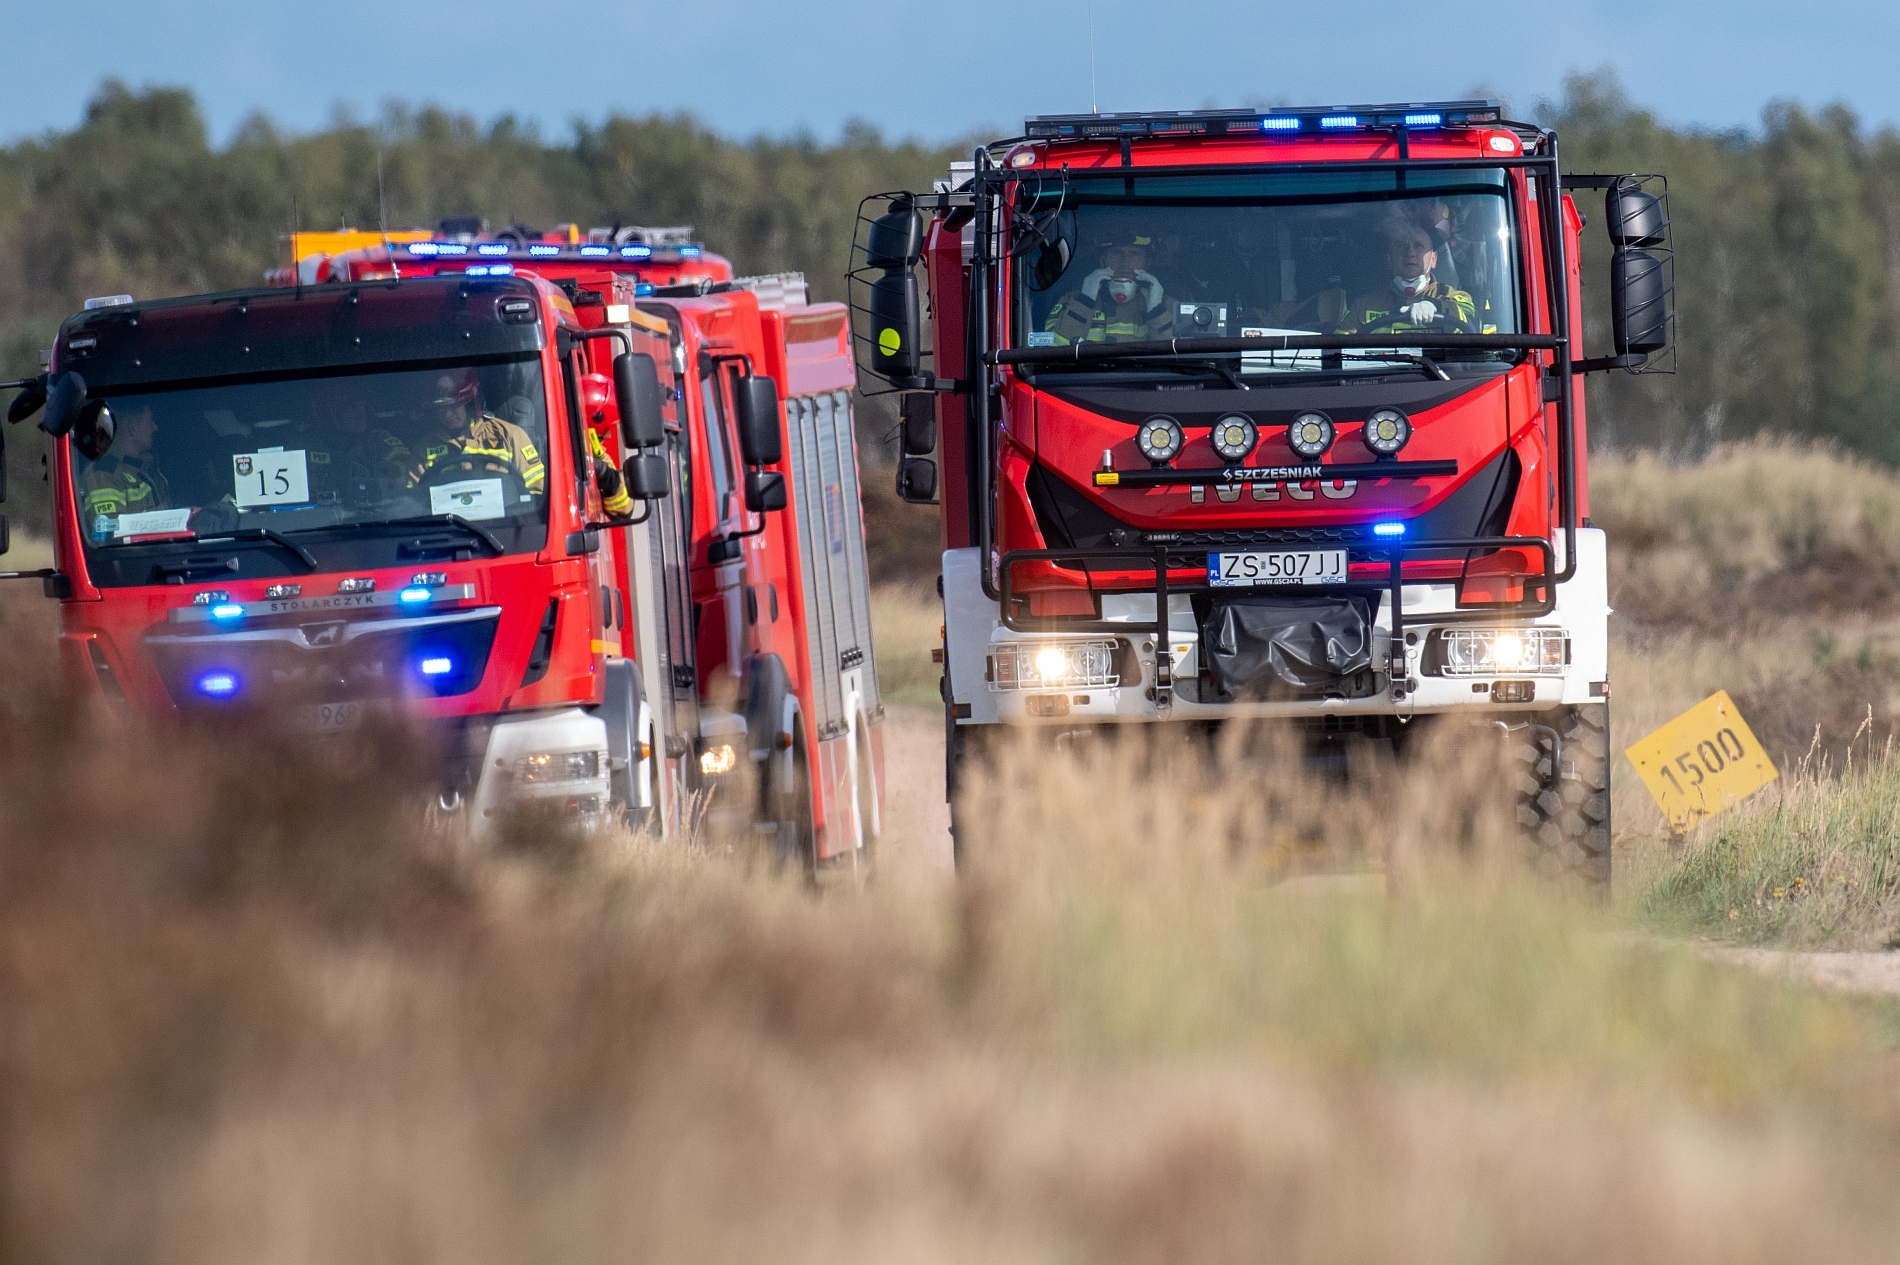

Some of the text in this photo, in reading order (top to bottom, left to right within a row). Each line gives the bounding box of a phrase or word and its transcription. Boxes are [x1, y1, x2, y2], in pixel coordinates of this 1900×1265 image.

[257, 468, 289, 496] 15
[97, 503, 112, 513] PSP
[1224, 553, 1340, 578] ZS 507JJ
[271, 595, 375, 612] STOLARCZYK
[1660, 728, 1744, 795] 1500
